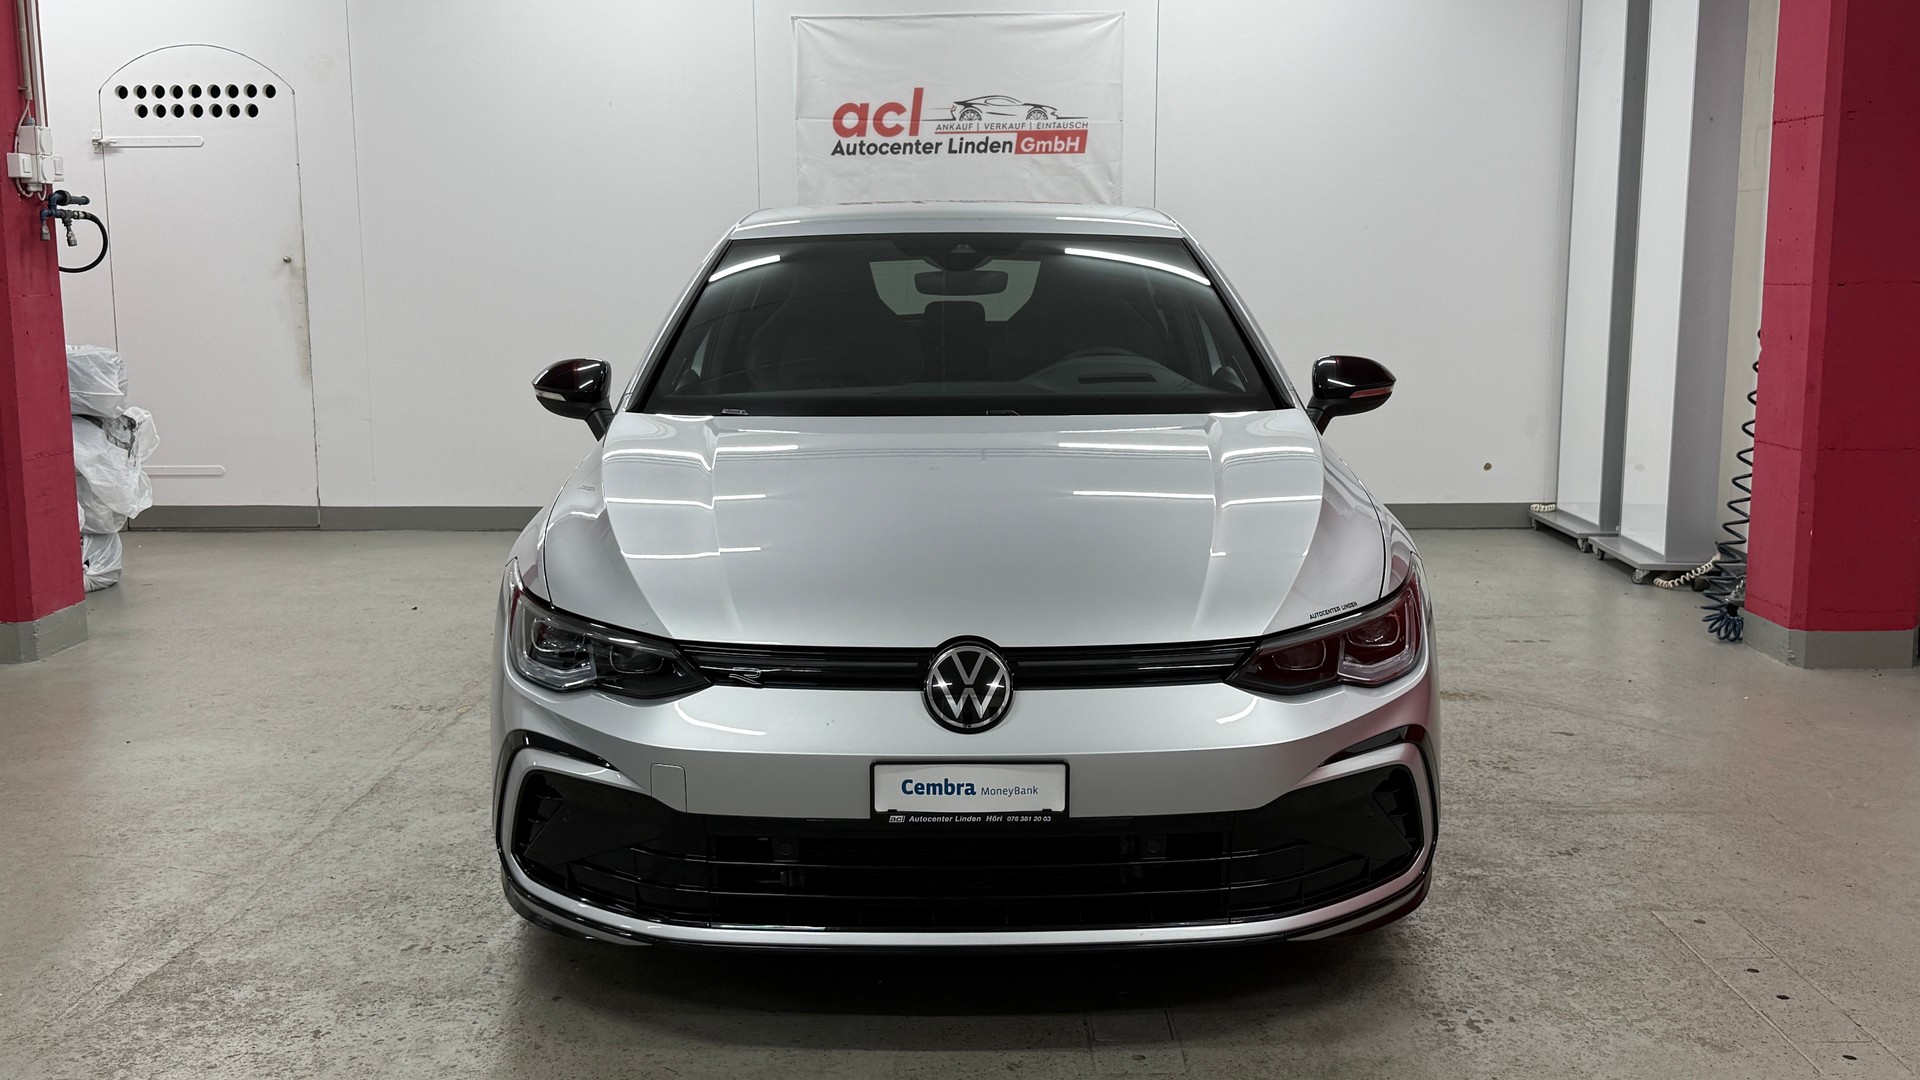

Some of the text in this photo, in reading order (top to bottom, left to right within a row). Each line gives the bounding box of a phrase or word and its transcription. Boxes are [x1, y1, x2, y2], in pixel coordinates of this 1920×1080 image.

[832, 87, 924, 138] acl
[936, 121, 1088, 131] ANKAUF VERKAUF EINTAUSCH
[831, 136, 1080, 156] Autocenter Linden GmbH
[1309, 605, 1341, 620] AUTOCENTER
[901, 778, 1038, 797] Cembra MoneyBank
[908, 815, 953, 823] Autocenter
[954, 815, 982, 823] Linden
